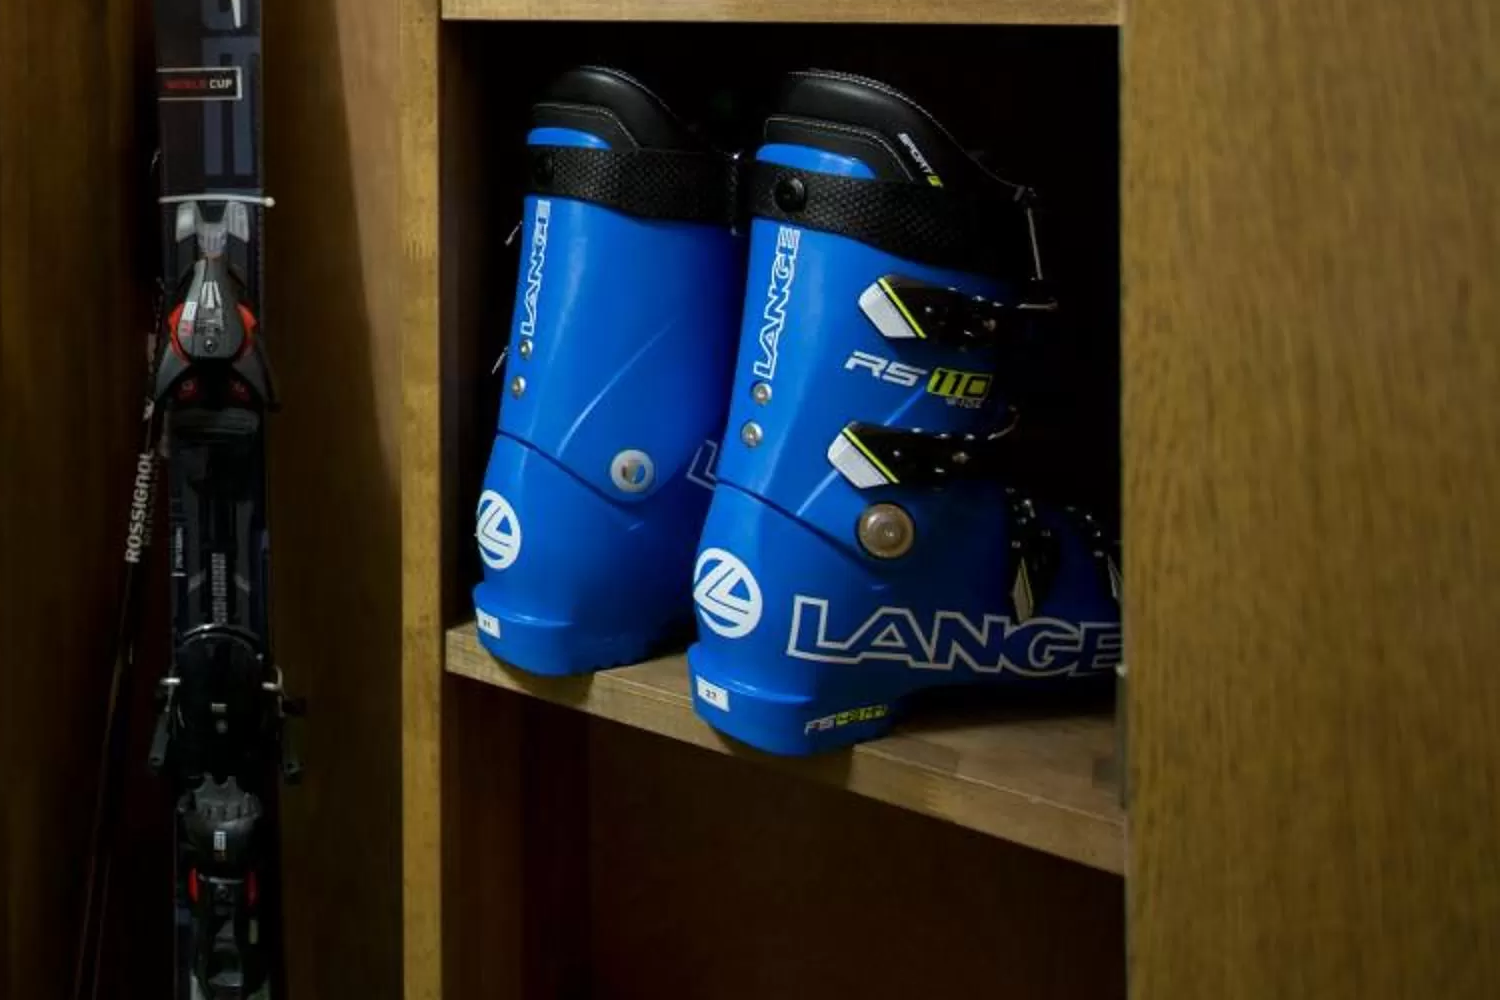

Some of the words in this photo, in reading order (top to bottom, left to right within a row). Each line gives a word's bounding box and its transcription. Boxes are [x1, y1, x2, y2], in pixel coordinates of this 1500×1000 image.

[209, 78, 233, 89] CUP
[520, 200, 551, 337] LANGE
[753, 225, 800, 380] LANGE
[844, 349, 928, 388] RS
[931, 369, 991, 399] 110
[124, 449, 155, 564] ROSSIGNOL
[787, 595, 1121, 679] LANGE
